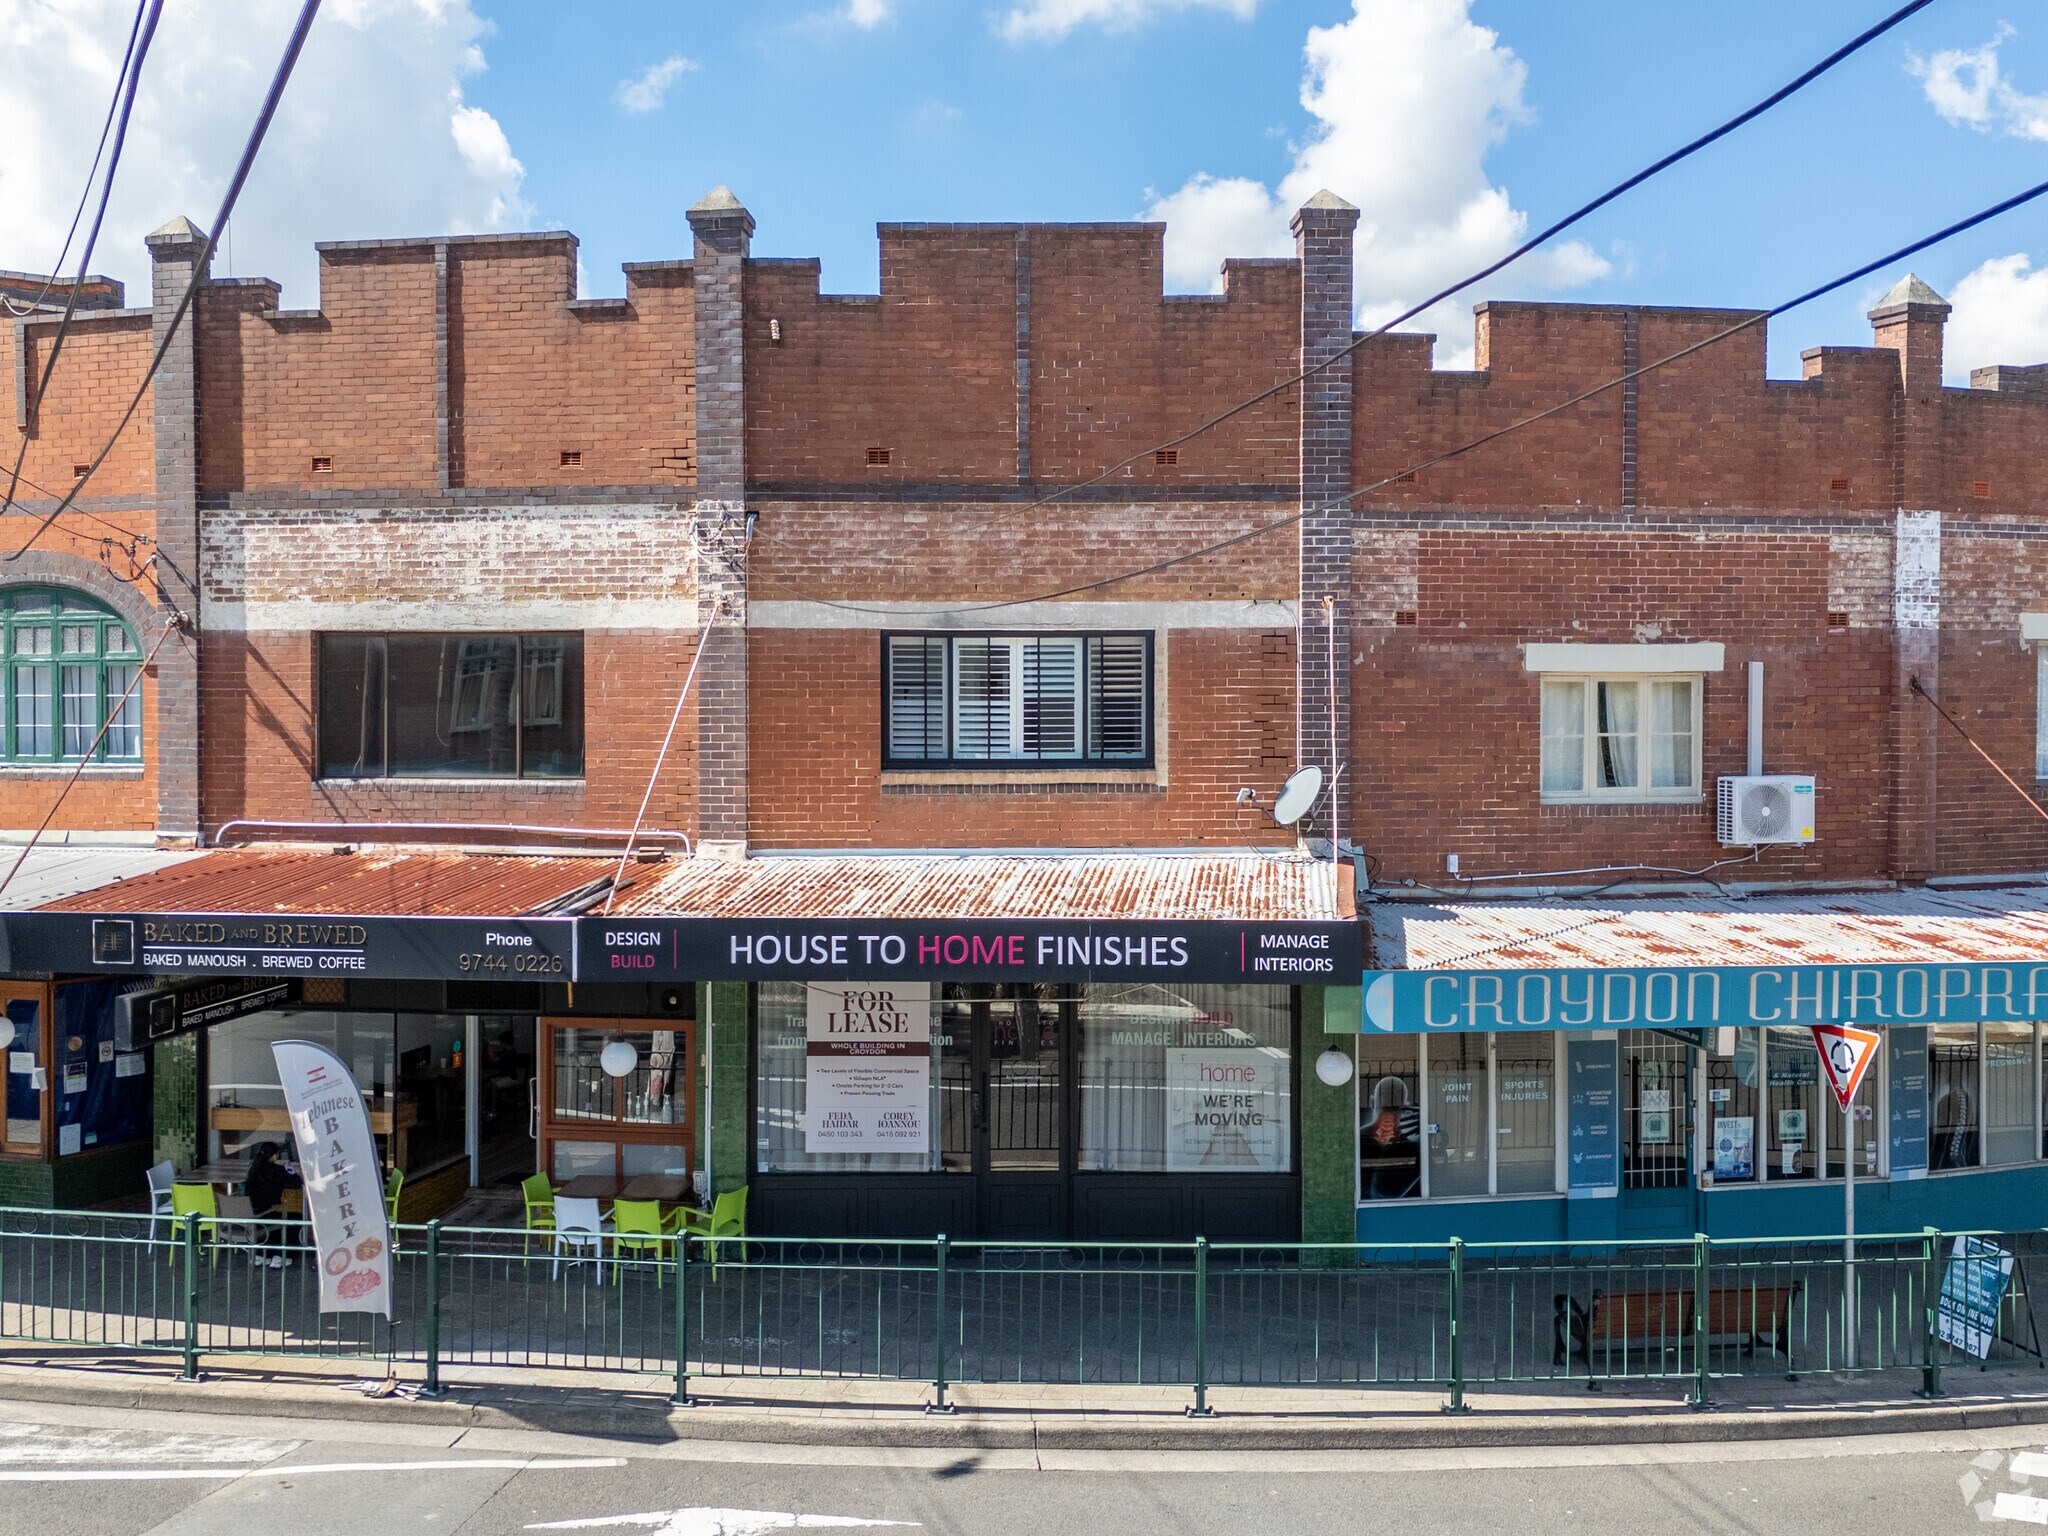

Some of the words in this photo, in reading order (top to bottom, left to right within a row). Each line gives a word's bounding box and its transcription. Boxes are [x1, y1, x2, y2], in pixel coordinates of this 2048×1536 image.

[143, 923, 225, 943] BAKED
[230, 927, 259, 940] AND
[263, 924, 367, 945] BREWED
[485, 932, 533, 946] Phone
[605, 931, 661, 946] DESIGN
[1260, 934, 1330, 949] MANAGE
[730, 934, 849, 965] HOUSE
[858, 934, 906, 965] TO
[918, 935, 1025, 966] HOME
[1037, 935, 1189, 967] FINISHES
[143, 953, 182, 967] BAKED
[187, 954, 247, 968] MANOUSH
[262, 955, 313, 969] BREWED
[318, 956, 366, 970] COFFEE
[459, 953, 508, 972] 9744
[514, 954, 563, 973] 0226
[611, 954, 656, 968] BUILD
[1254, 957, 1334, 972] INTERIORS
[183, 984, 226, 1009] BAKED
[842, 990, 896, 1012] FOR
[1424, 971, 1719, 1027] CROYDON
[181, 1013, 203, 1027] BAKED
[205, 1004, 235, 1020] MANOUSH
[241, 995, 266, 1010] BREWED
[1193, 1011, 1233, 1025] BUILD
[828, 1012, 909, 1033] LEASE
[777, 1033, 808, 1047] from
[928, 1033, 953, 1046] tion
[830, 1042, 858, 1050] WHOLE
[859, 1042, 896, 1050] BUILDING
[896, 1042, 906, 1050] IN
[1111, 1032, 1171, 1046] MANAGE
[1183, 1032, 1257, 1046] INTERIORS
[1200, 1062, 1256, 1082] home
[1781, 1071, 1810, 1079] Natural
[1442, 1083, 1472, 1092] JOINT
[1504, 1080, 1544, 1090] SPORTS
[1203, 1094, 1254, 1108] WE'RE
[1446, 1094, 1469, 1103] PAIN
[1501, 1091, 1548, 1101] INJURIES
[828, 1112, 853, 1120] FEDA
[883, 1112, 915, 1120] COREY
[1194, 1113, 1263, 1126] MOVING
[822, 1120, 859, 1128] HAIDAR
[1717, 1120, 1738, 1129] INVEST
[817, 1130, 835, 1138] 0450
[836, 1130, 850, 1138] 103
[850, 1130, 863, 1138] 343
[876, 1130, 894, 1138] 0415
[894, 1130, 908, 1138] 092
[908, 1130, 921, 1138] 921
[323, 1116, 358, 1240] BAKERY
